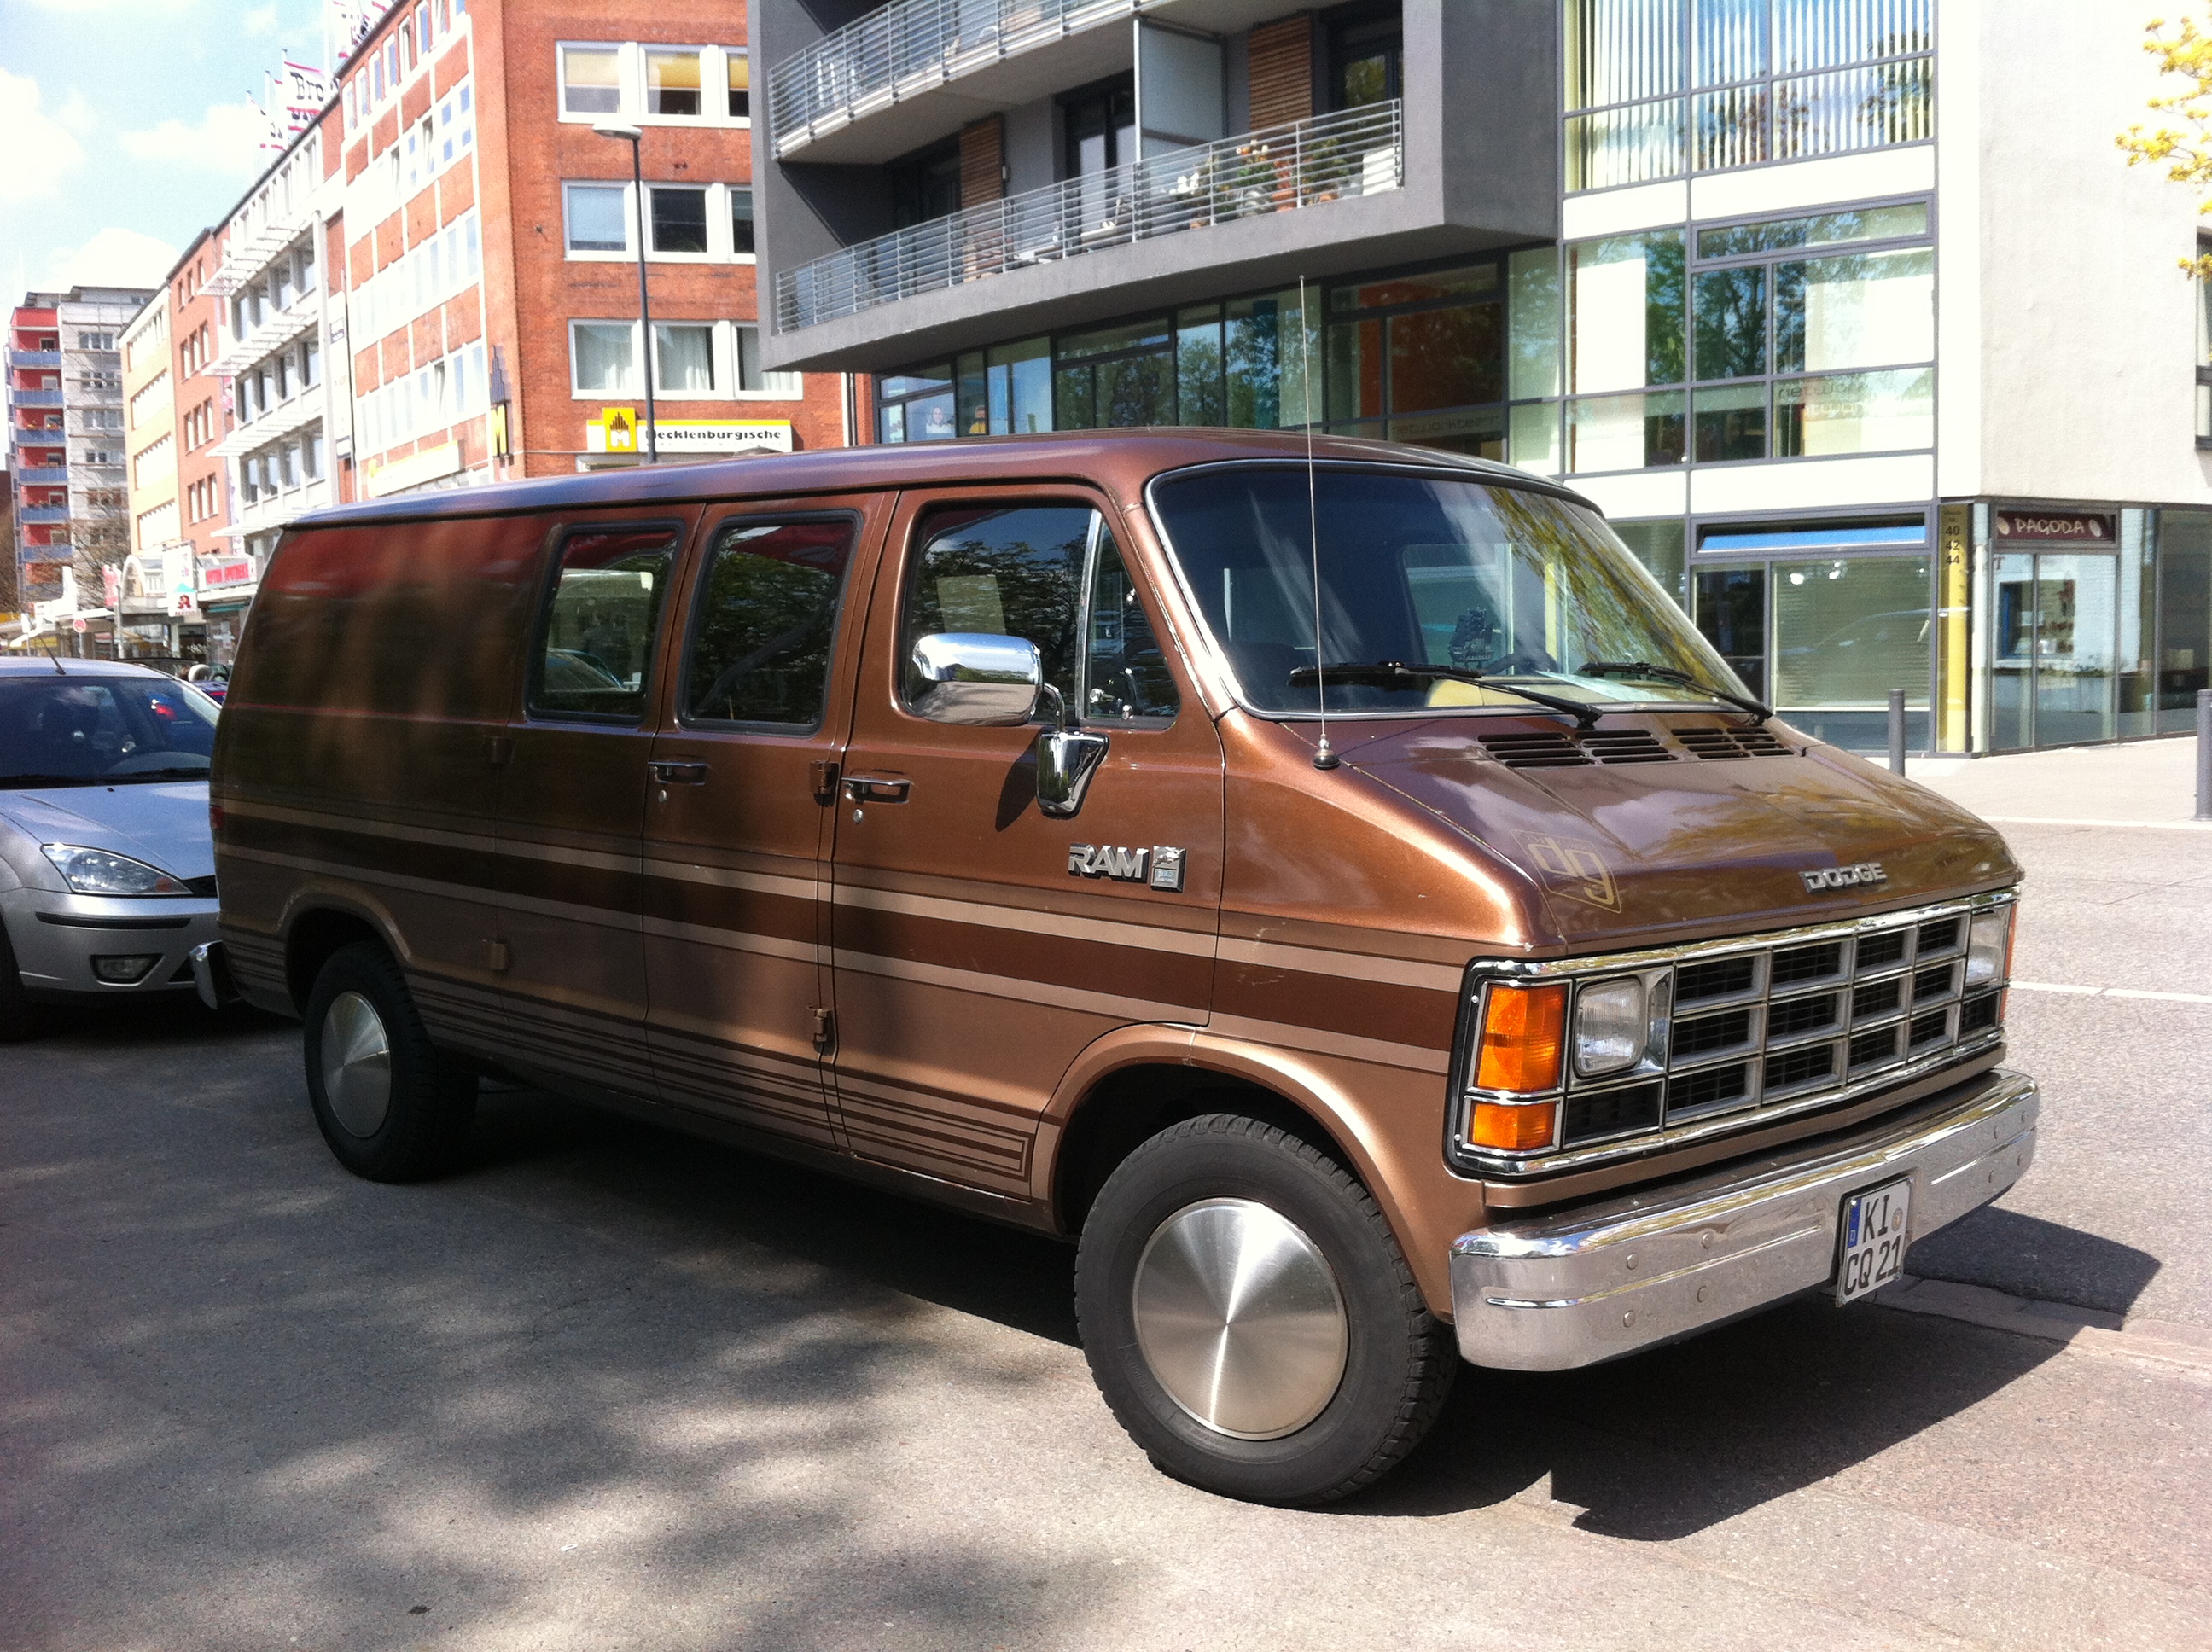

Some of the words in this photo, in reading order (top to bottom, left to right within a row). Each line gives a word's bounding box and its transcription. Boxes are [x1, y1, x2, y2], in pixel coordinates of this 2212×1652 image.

[1945, 526, 1960, 536] 40
[2014, 517, 2085, 535] PAGODA
[1945, 540, 1960, 550] 42
[1945, 555, 1960, 565] 44
[1068, 843, 1149, 882] RAM
[1801, 862, 1888, 892] DODGE
[1862, 1195, 1890, 1243] KI
[1849, 1230, 1856, 1242] D
[1844, 1247, 1874, 1296] CQ
[1875, 1234, 1901, 1283] 21
